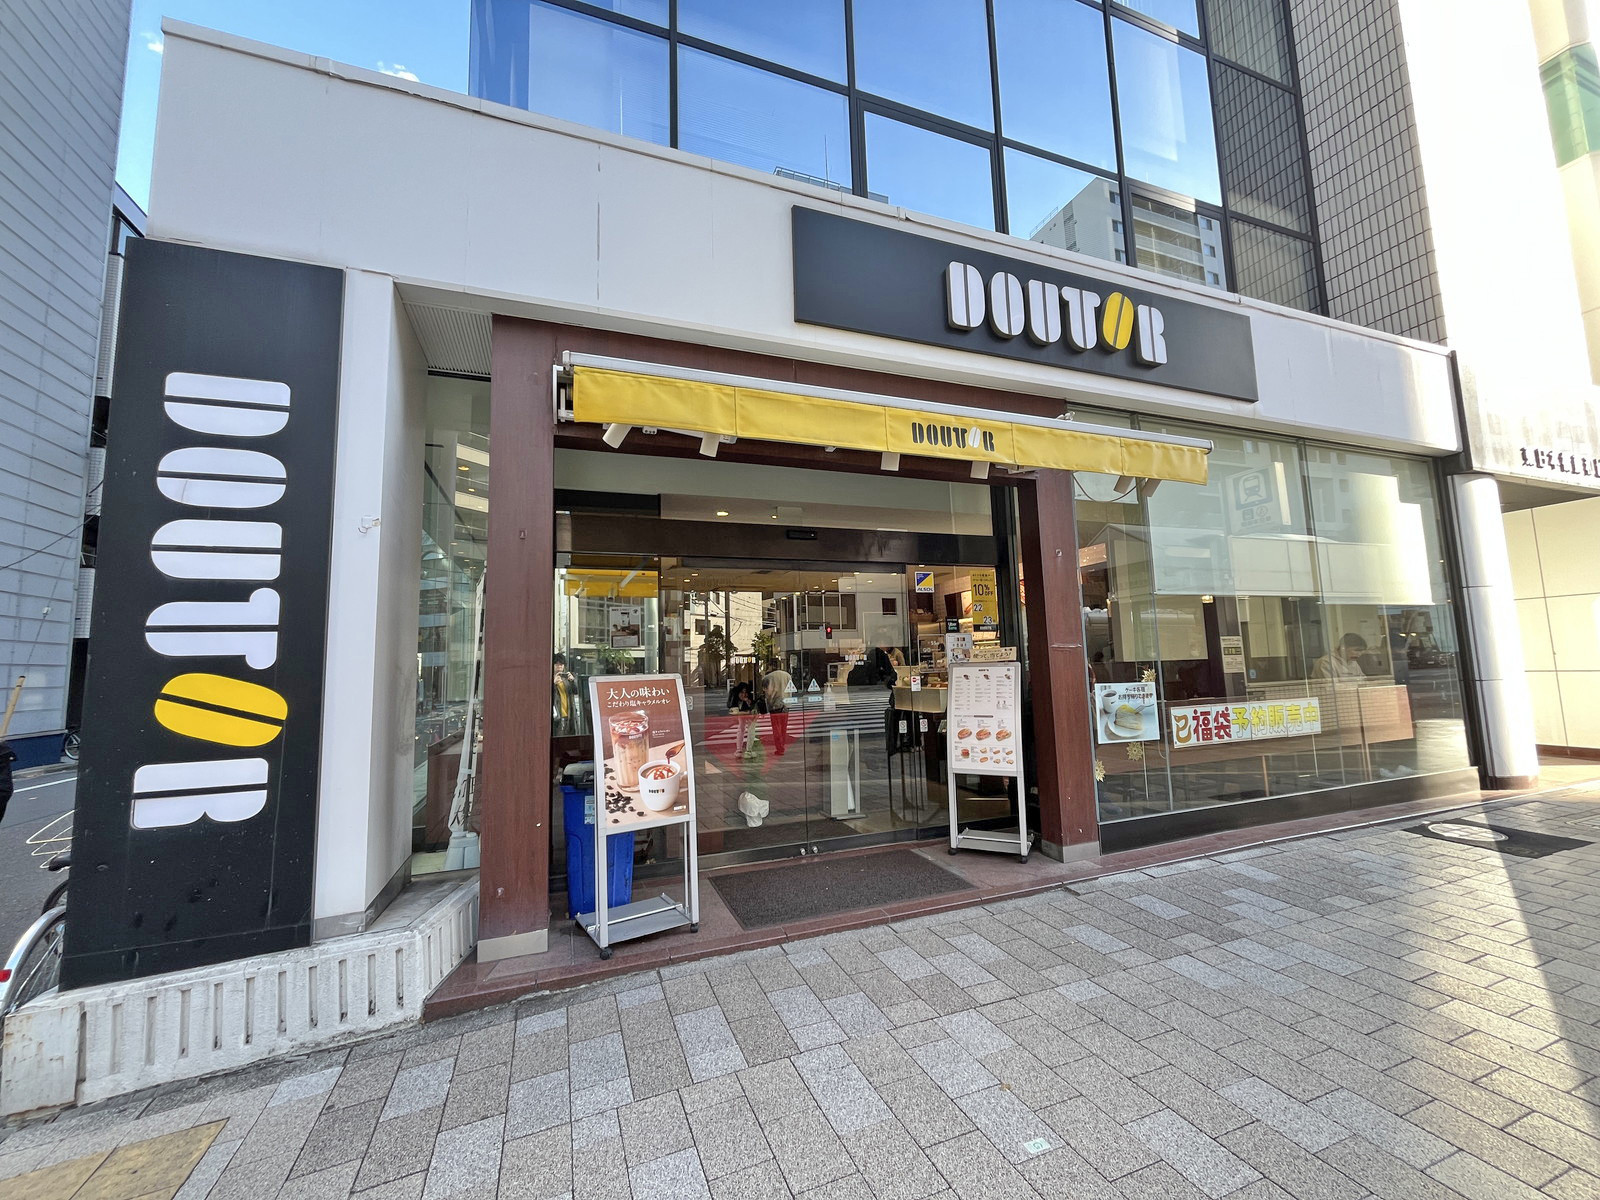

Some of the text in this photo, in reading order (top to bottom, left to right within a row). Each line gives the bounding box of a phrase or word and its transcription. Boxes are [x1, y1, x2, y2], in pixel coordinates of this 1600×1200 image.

[947, 261, 1167, 366] DOUTOR
[911, 422, 995, 452] DOUTOR
[130, 372, 291, 828] DOUTOR
[606, 686, 670, 701] 大人の味わい
[607, 698, 671, 708] こだわり塩キャラメルオレ
